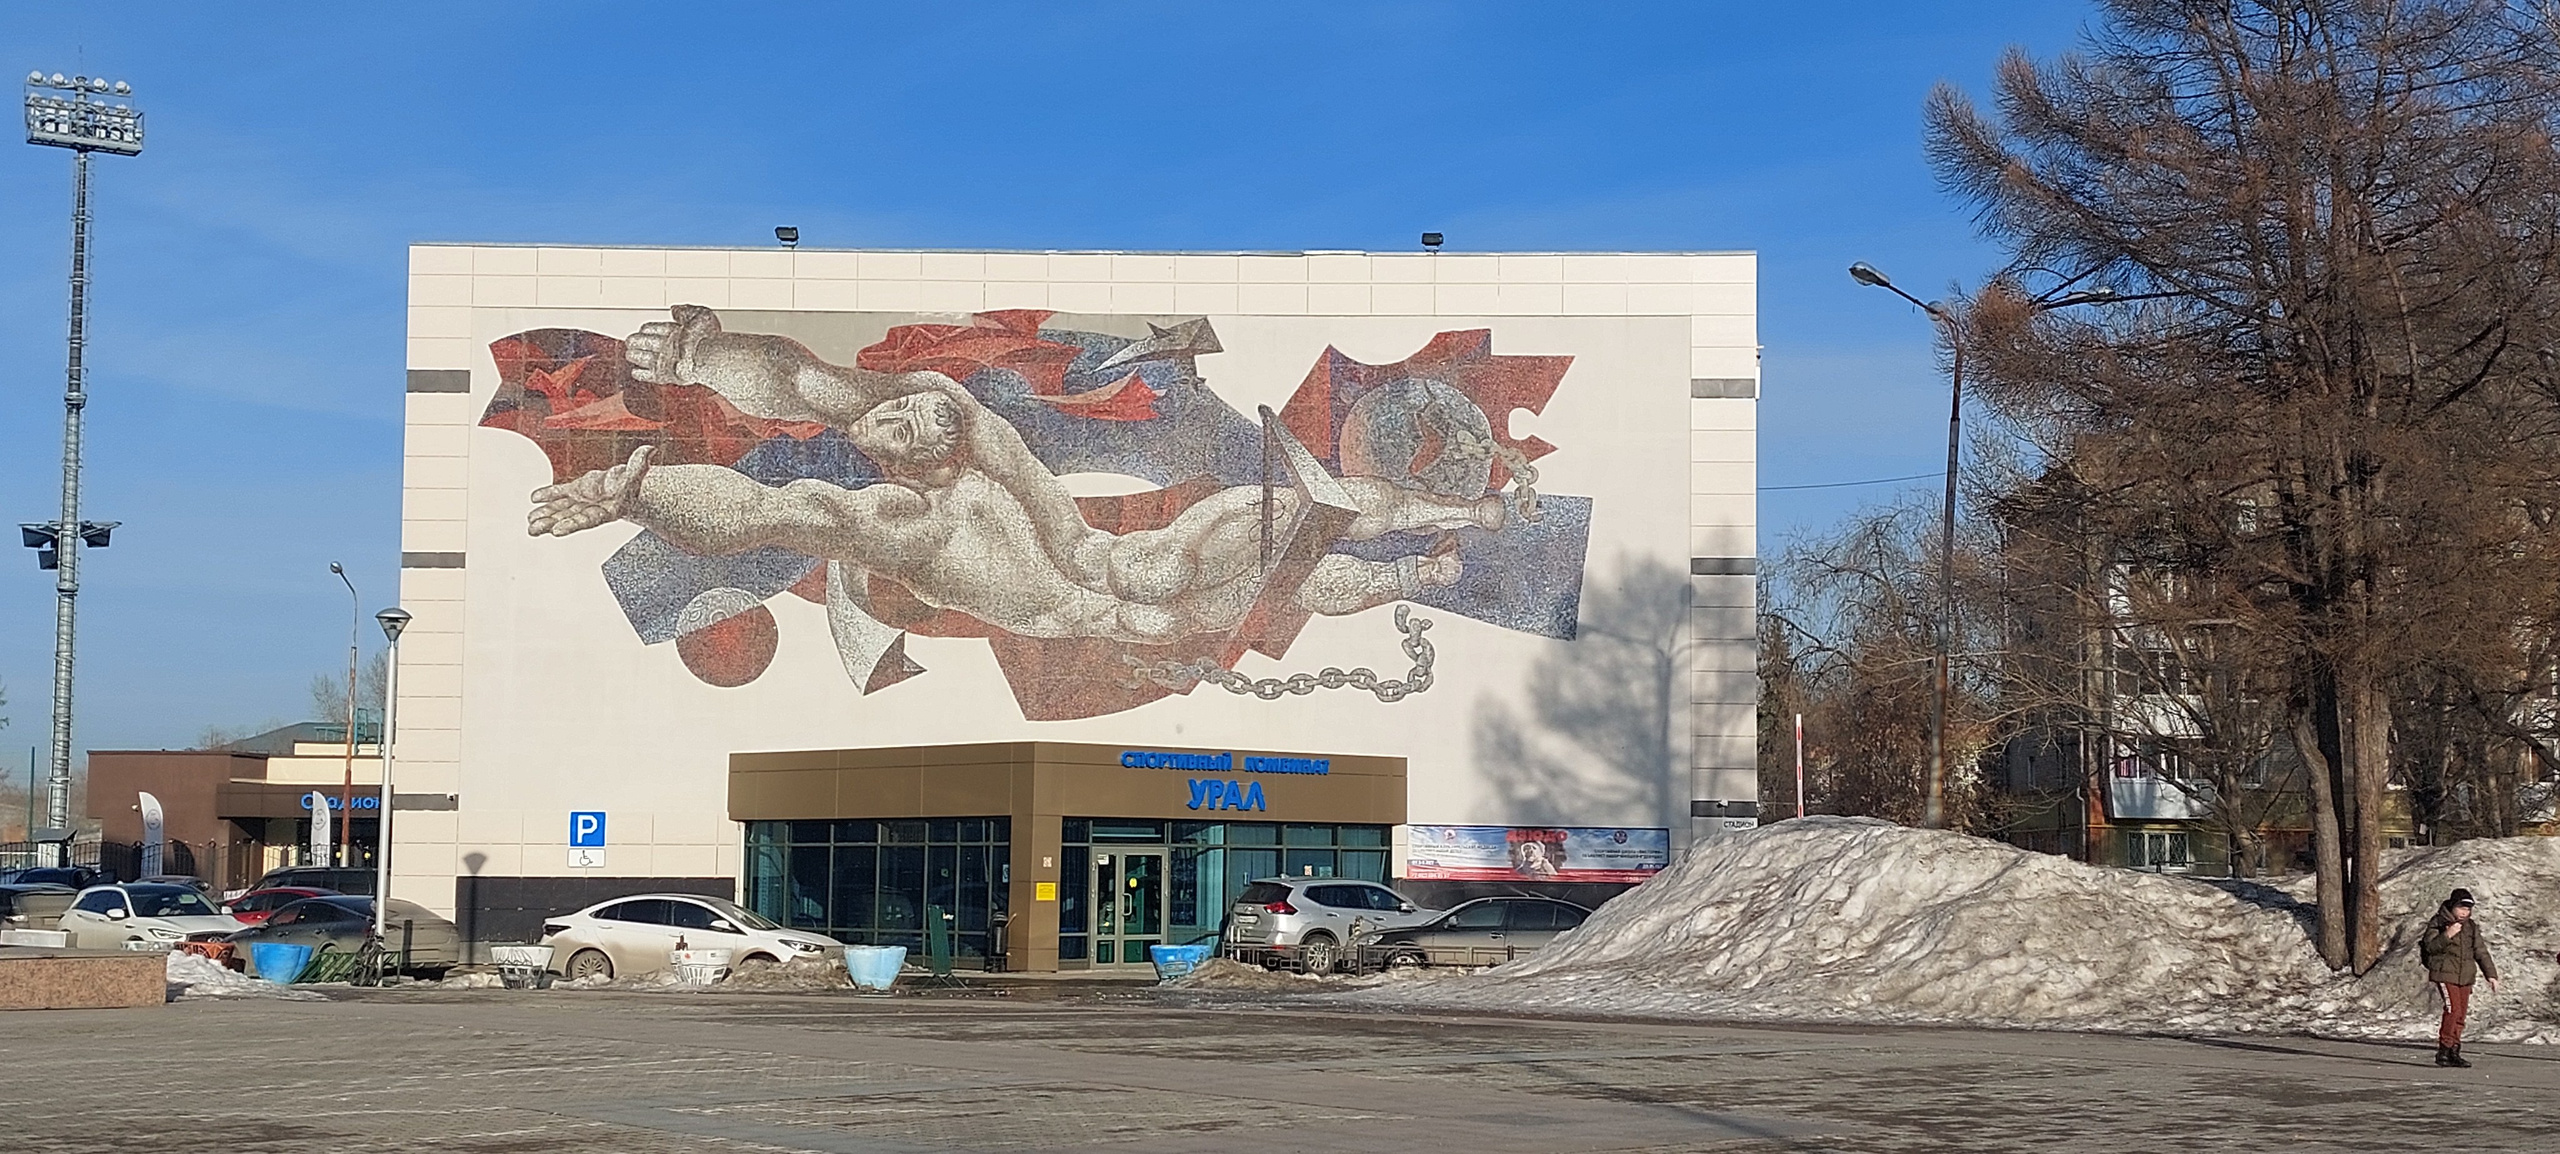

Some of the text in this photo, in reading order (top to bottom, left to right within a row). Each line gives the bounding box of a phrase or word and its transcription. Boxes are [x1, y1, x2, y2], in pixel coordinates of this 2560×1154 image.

[1121, 751, 1330, 775] СПОРТИВНЫЙ КОМБИНАТ
[1186, 778, 1266, 811] УРАЛ
[577, 814, 598, 843] P
[1505, 829, 1569, 843] ДЗЮДО
[1723, 820, 1755, 829] СТАДИОН
